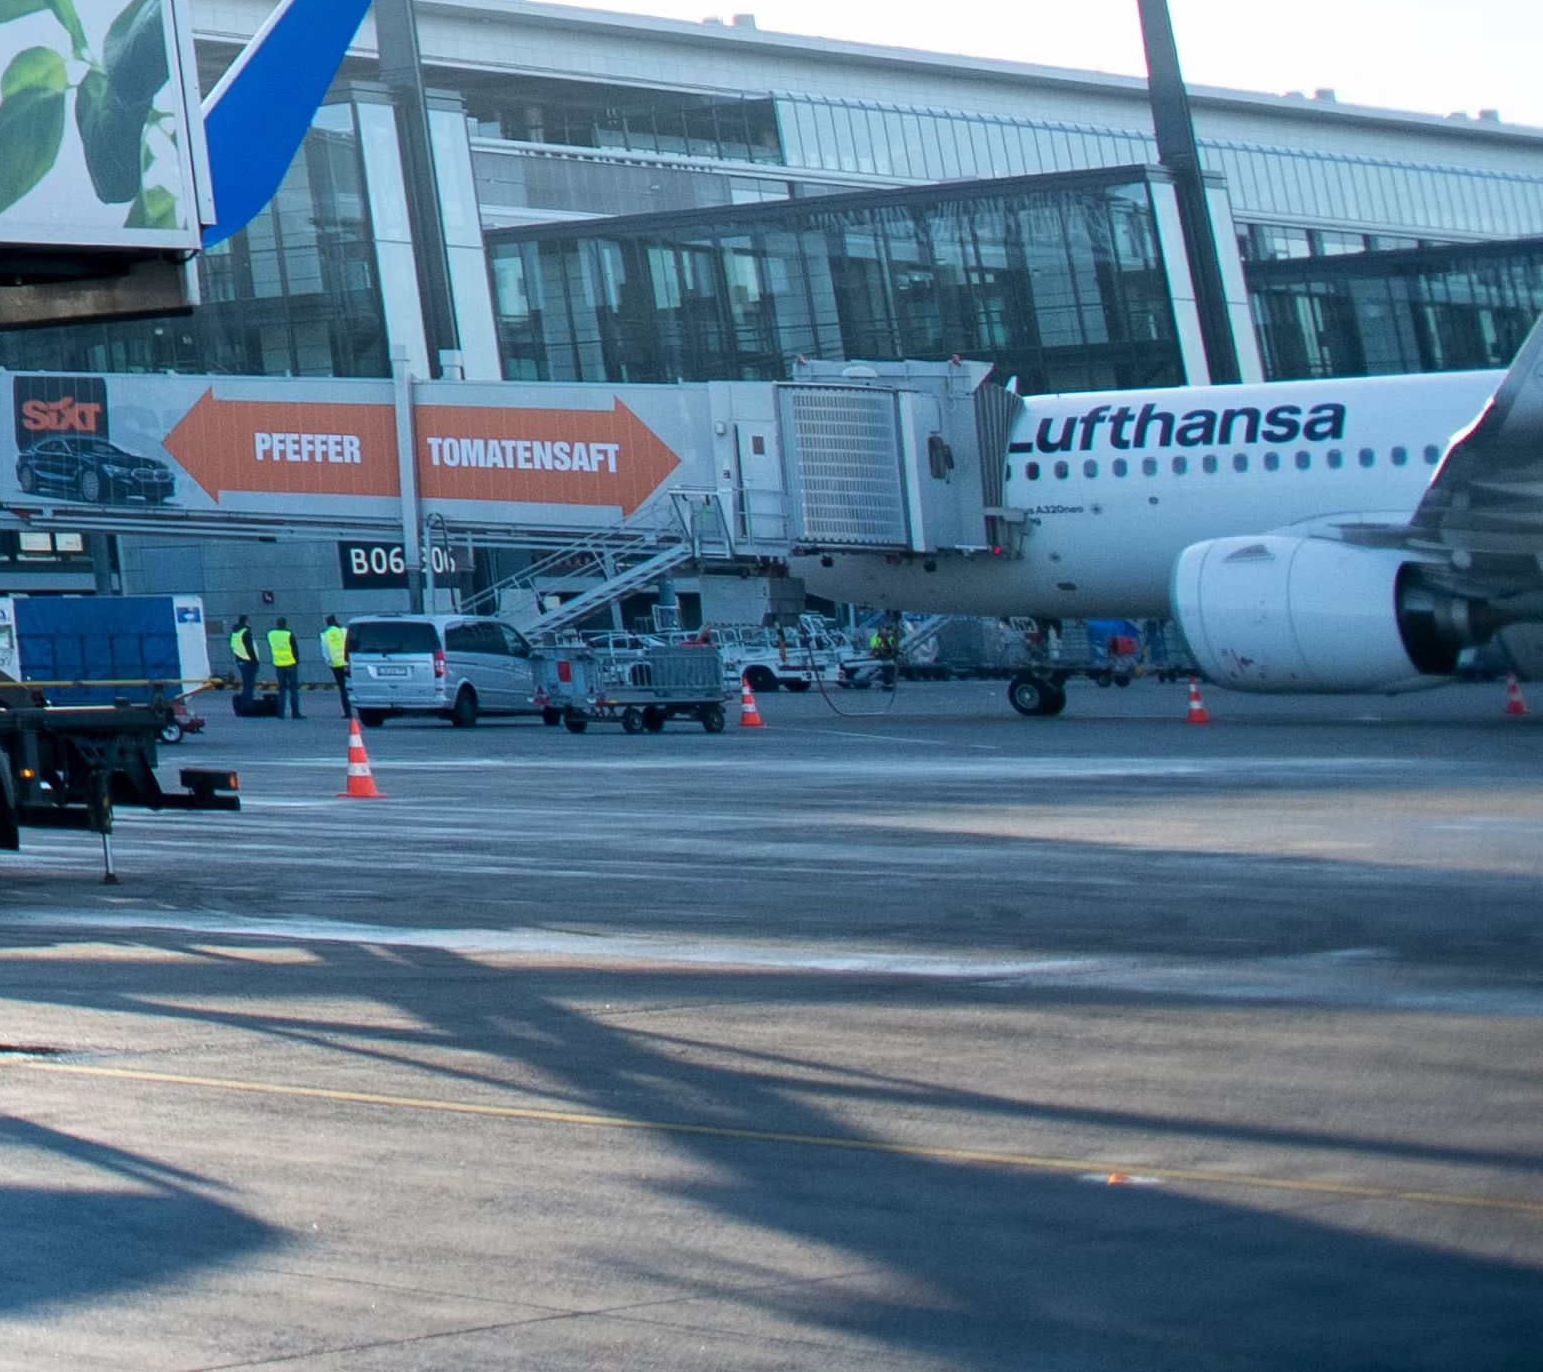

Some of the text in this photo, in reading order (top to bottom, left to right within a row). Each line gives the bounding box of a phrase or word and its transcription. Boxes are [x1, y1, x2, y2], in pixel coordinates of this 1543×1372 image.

[253, 432, 362, 464] PFEFFER
[426, 437, 620, 473] TOMATENSAFT
[350, 547, 405, 574] B06
